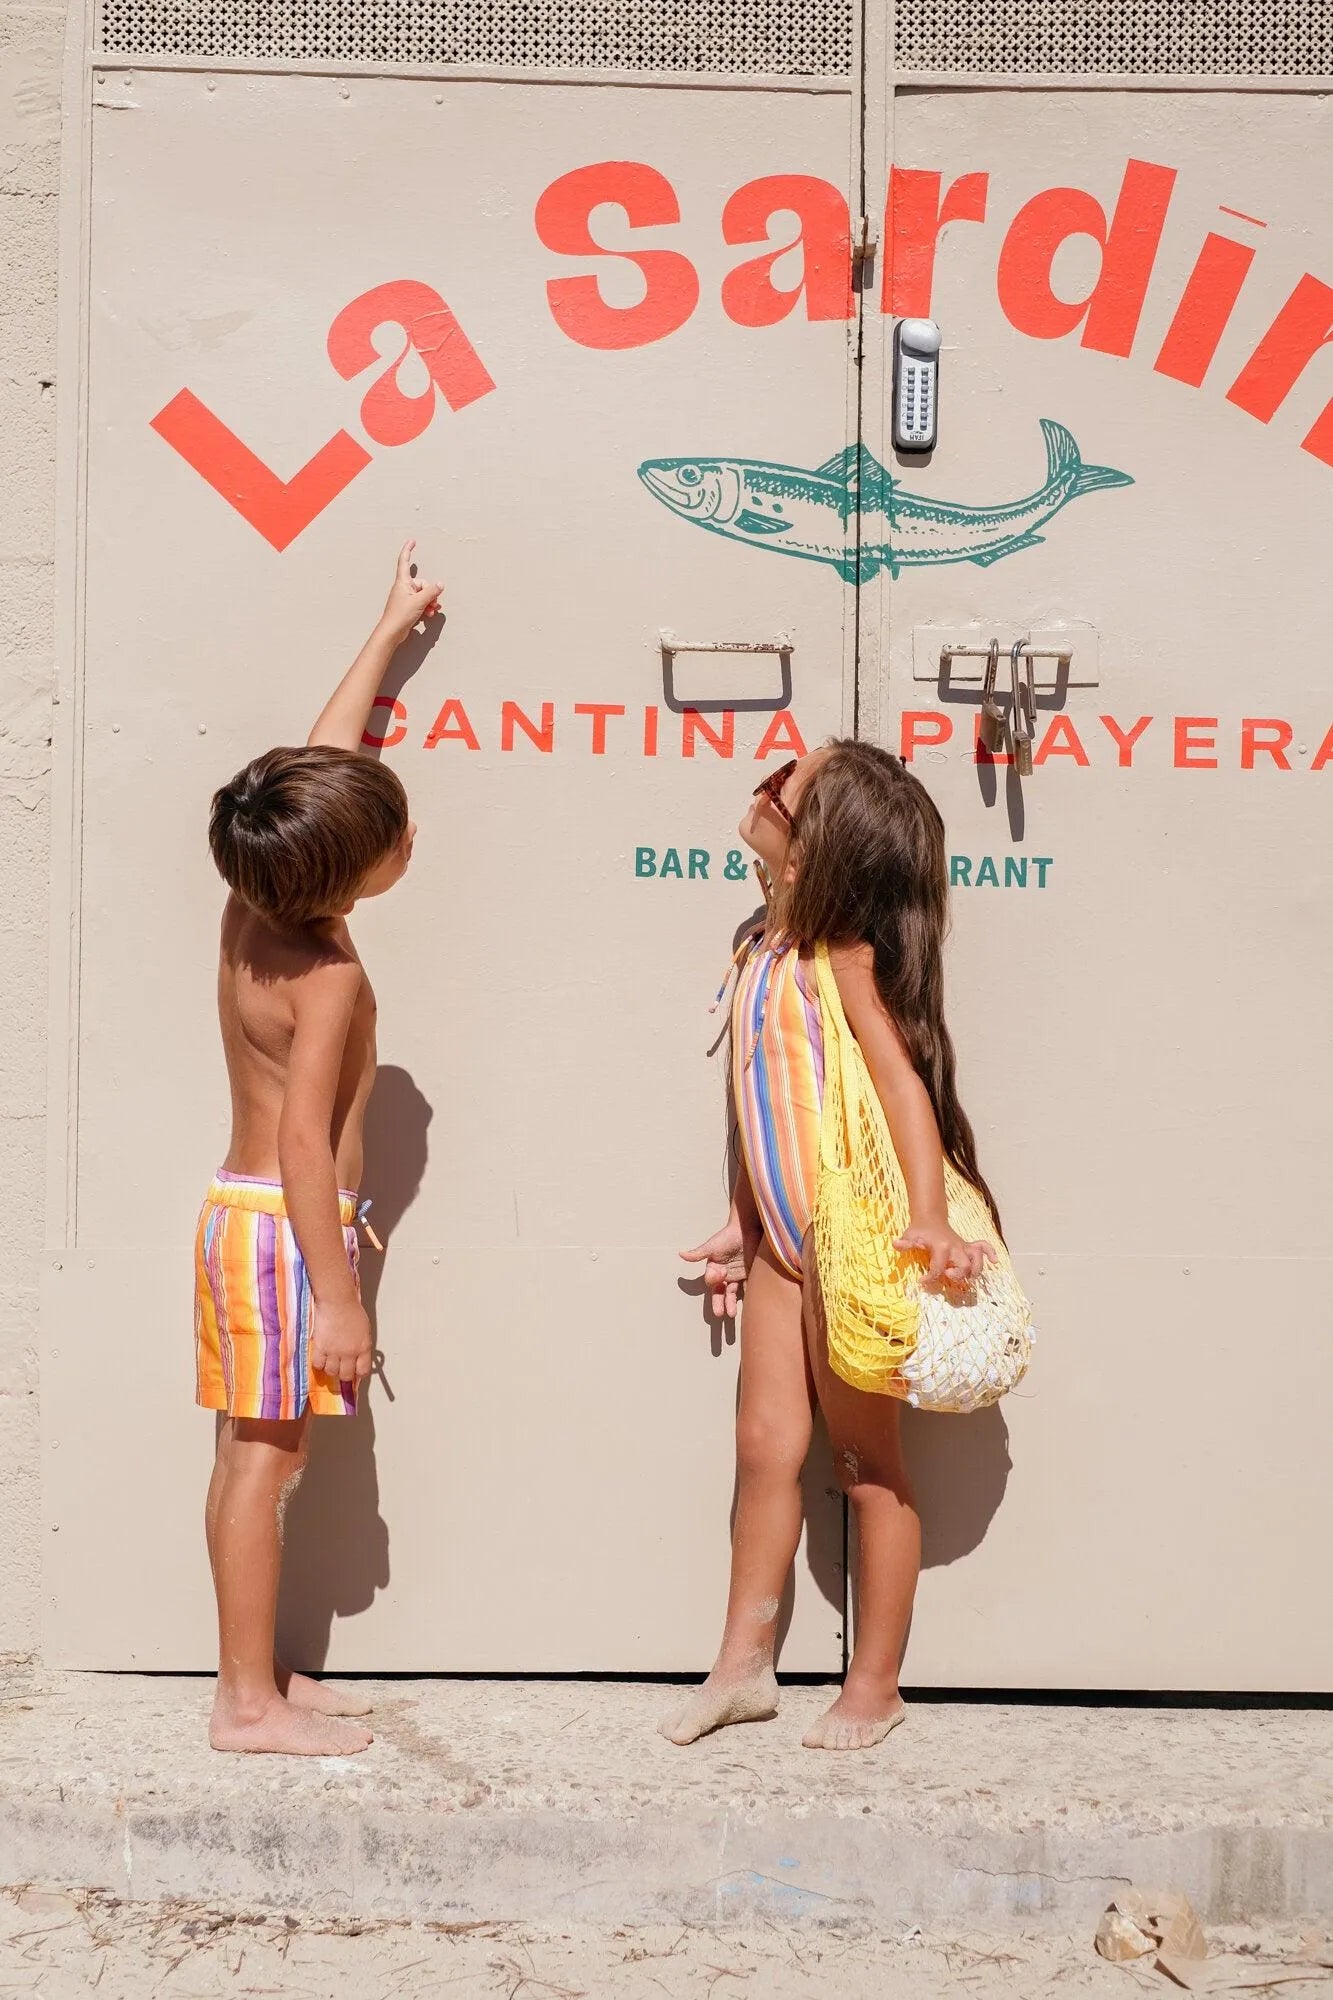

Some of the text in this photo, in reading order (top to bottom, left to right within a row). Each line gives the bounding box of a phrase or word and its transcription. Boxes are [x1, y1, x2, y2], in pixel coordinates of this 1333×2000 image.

[149, 279, 496, 553] La
[361, 696, 809, 761] CANTINA
[635, 847, 1053, 888] BAR & RANT
